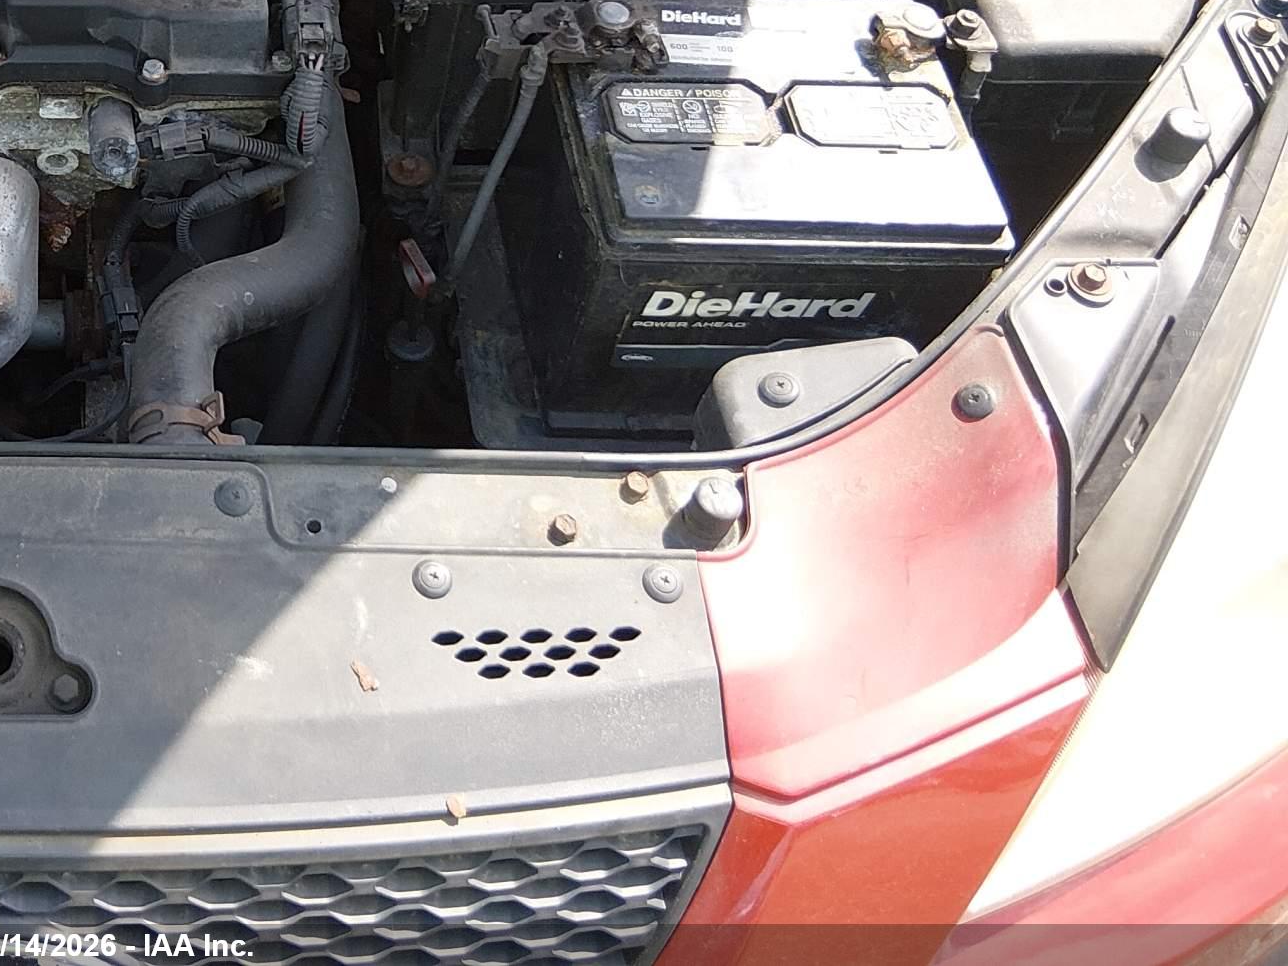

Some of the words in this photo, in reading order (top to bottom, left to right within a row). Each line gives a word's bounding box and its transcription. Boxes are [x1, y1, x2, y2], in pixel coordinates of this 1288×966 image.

[661, 8, 742, 27] DieHard
[633, 87, 684, 98] DANGER
[641, 289, 877, 318] DieHard
[632, 320, 688, 328] POWER
[691, 321, 748, 329] AHEAD
